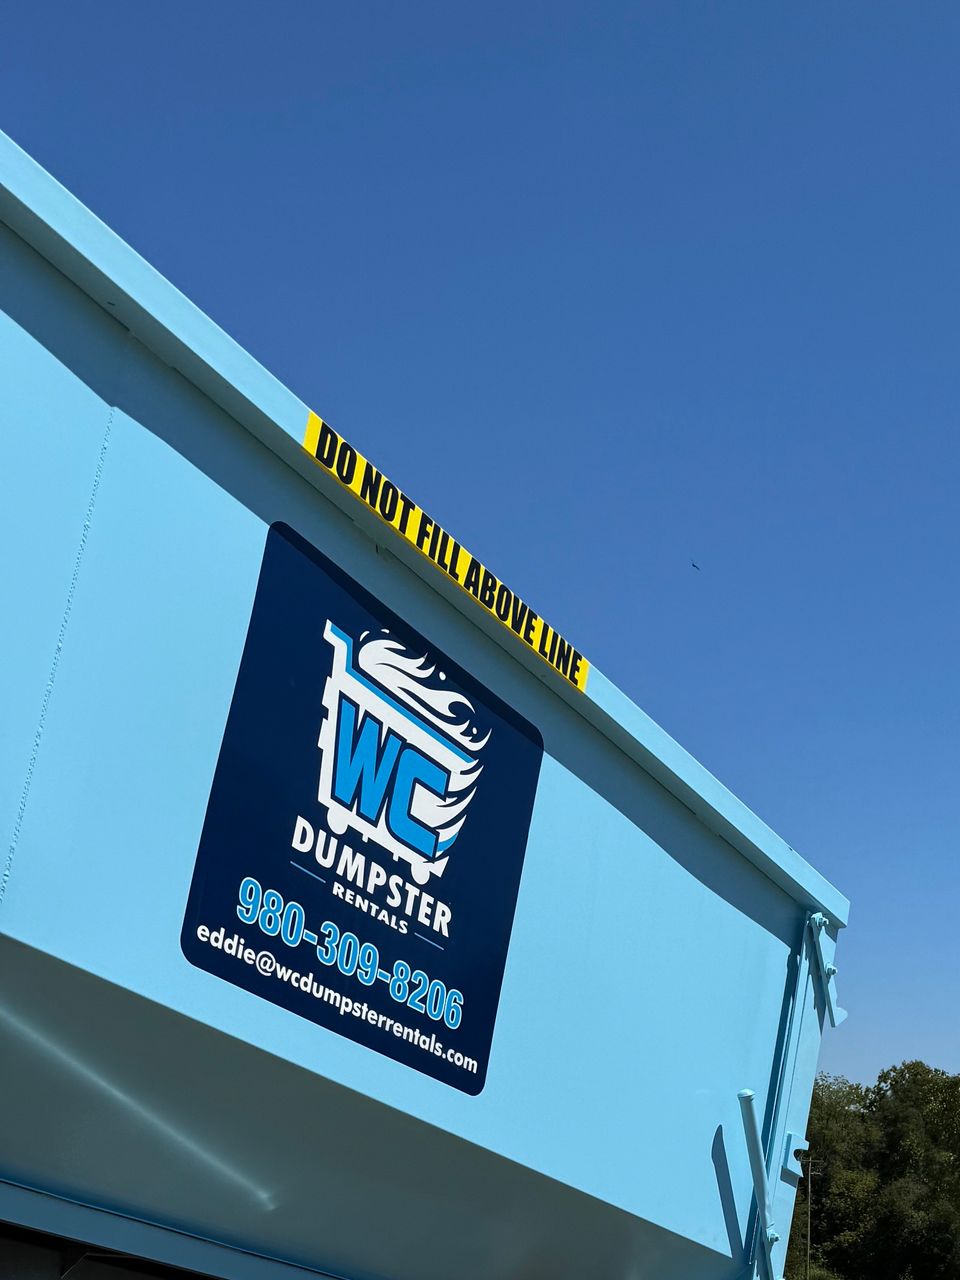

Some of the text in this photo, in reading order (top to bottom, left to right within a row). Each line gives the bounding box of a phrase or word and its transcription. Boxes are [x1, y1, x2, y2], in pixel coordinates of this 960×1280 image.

[315, 421, 583, 687] DO NOT FILL ABOVE LINE
[332, 698, 452, 857] WC
[291, 815, 452, 938] DUMPSTER
[332, 881, 409, 935] RENTALS
[197, 925, 478, 1074] eddie@wcdumpsterrentals.com
[236, 876, 464, 1030] 980-309-8206
